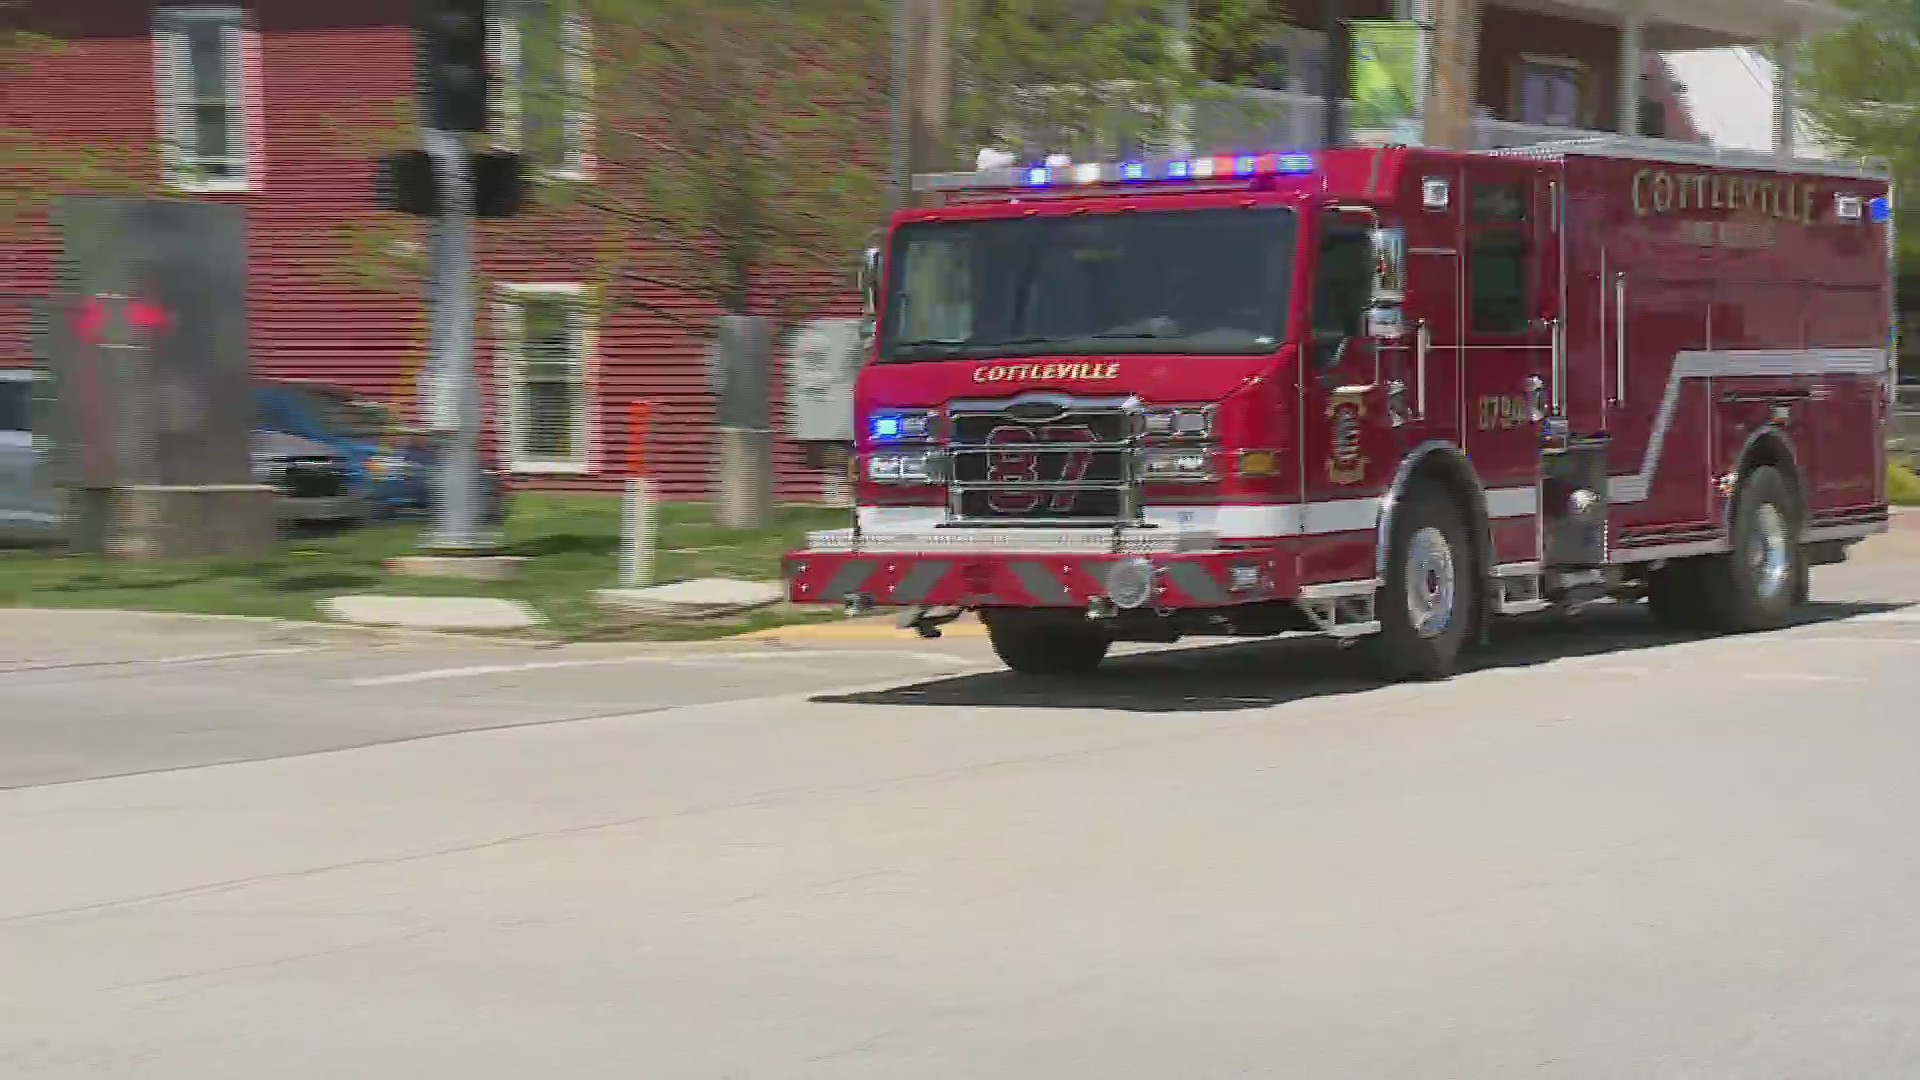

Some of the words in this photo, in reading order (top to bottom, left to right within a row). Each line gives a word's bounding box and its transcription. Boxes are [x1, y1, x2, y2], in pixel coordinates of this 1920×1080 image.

[1632, 168, 1818, 224] COTTLEVILLE
[972, 362, 1121, 383] COTTLEVILLE
[985, 424, 1101, 512] 87
